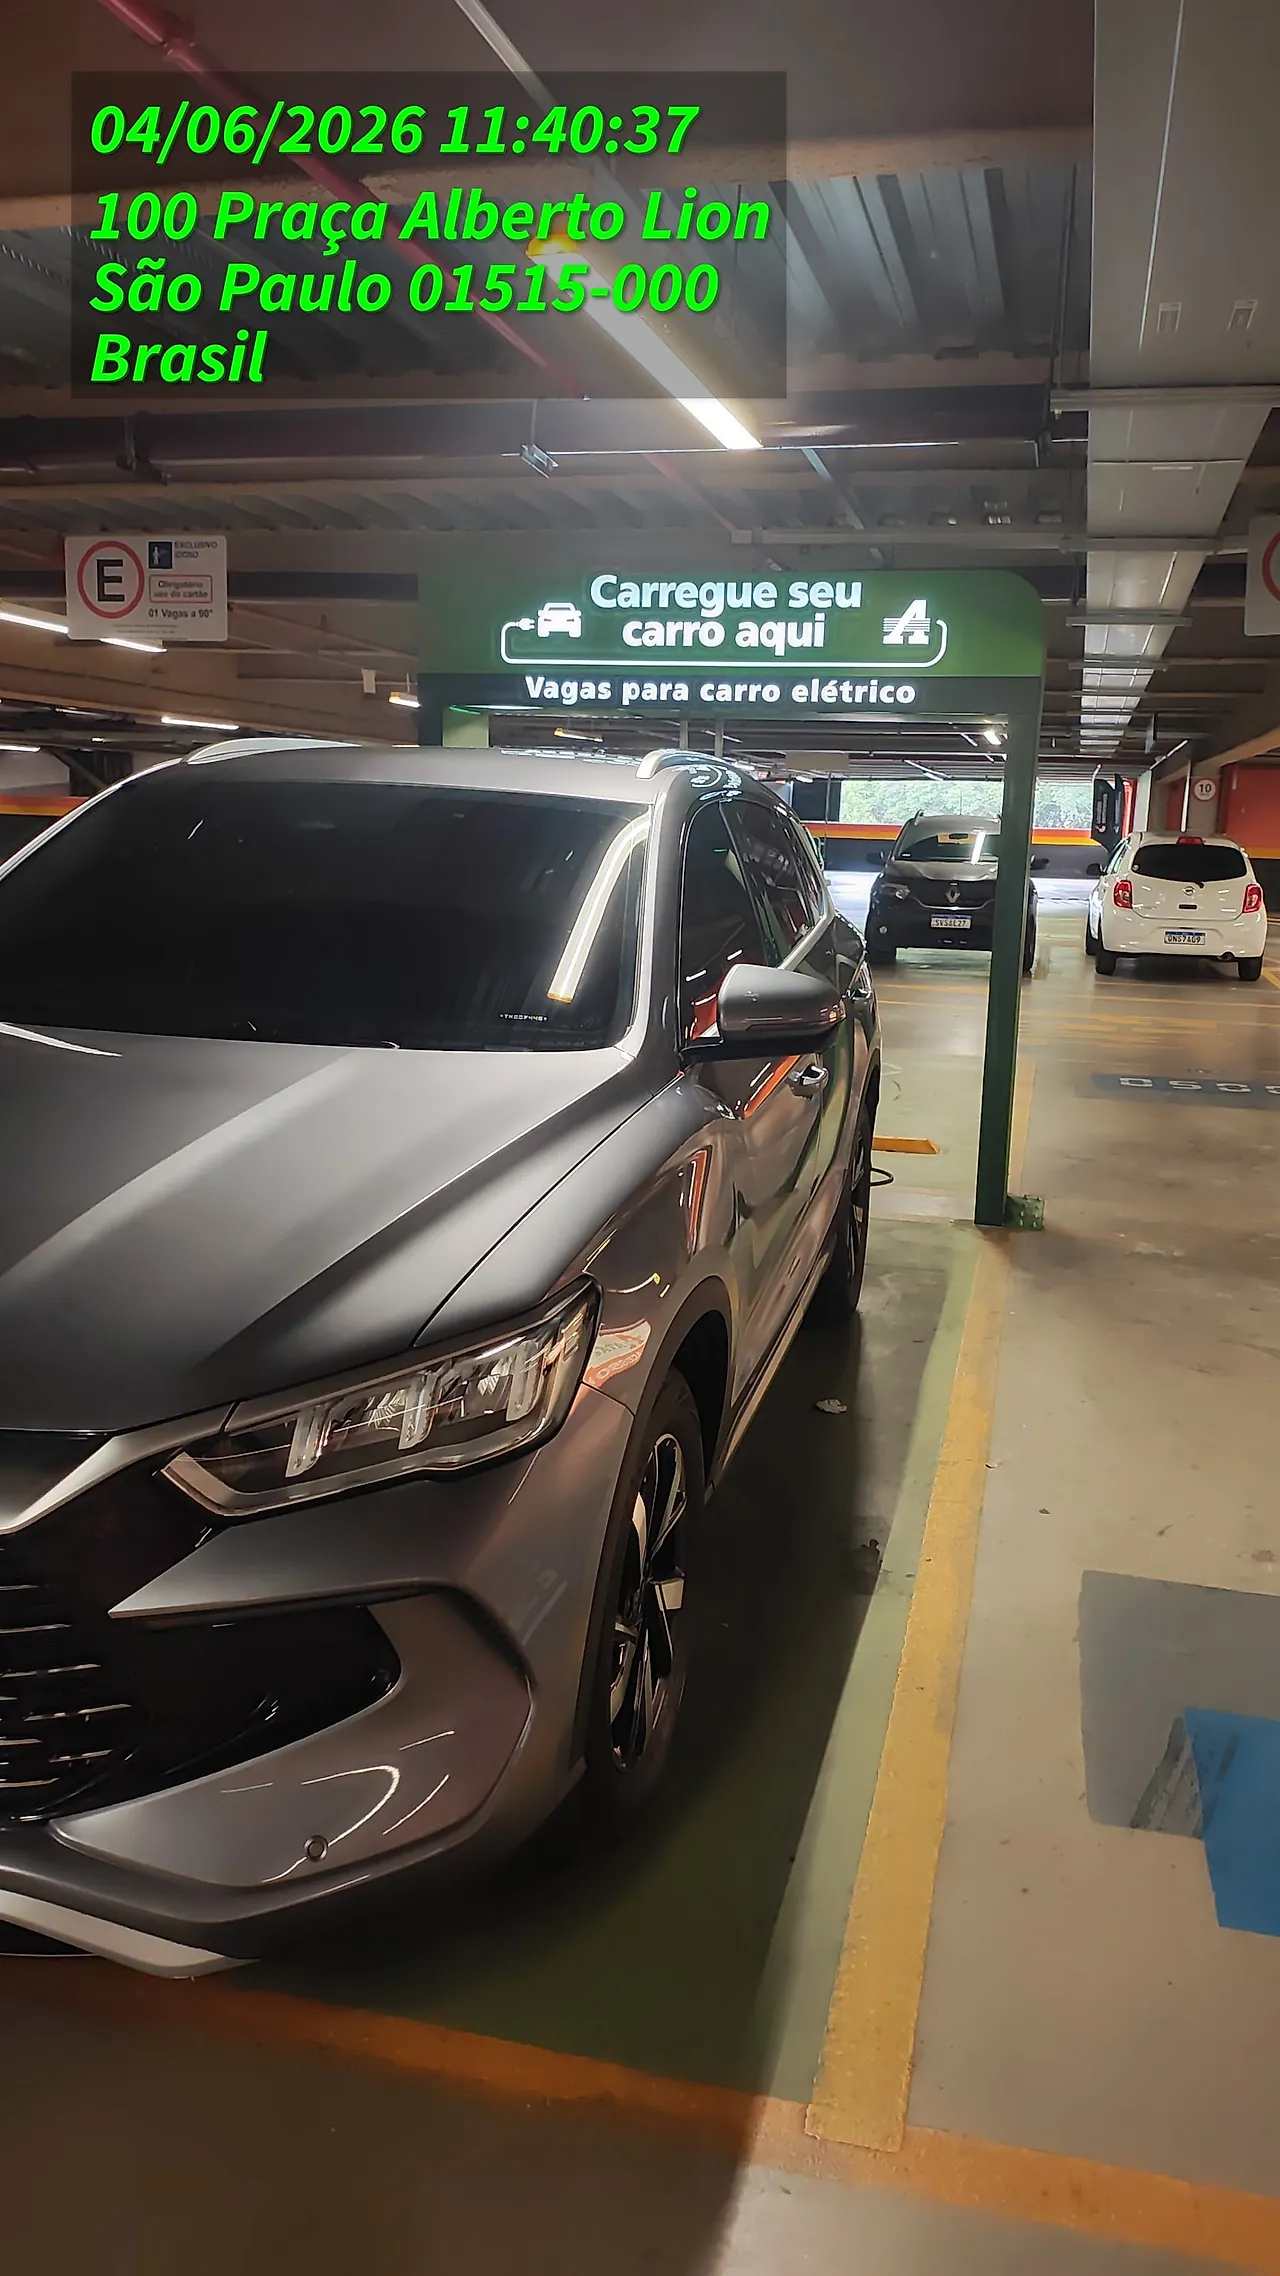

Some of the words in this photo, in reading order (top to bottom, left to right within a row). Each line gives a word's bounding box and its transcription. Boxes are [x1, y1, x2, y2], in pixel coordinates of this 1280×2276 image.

[96, 559, 125, 602] E
[590, 573, 778, 616] Carregue
[788, 580, 862, 609] seu
[161, 609, 188, 620] Vagas
[621, 617, 725, 649] carro
[735, 612, 827, 657] aqui
[525, 675, 612, 705] Vagas
[622, 682, 689, 706] para
[699, 683, 781, 704] carro
[791, 674, 918, 705] elétrico
[1199, 783, 1212, 793] 10
